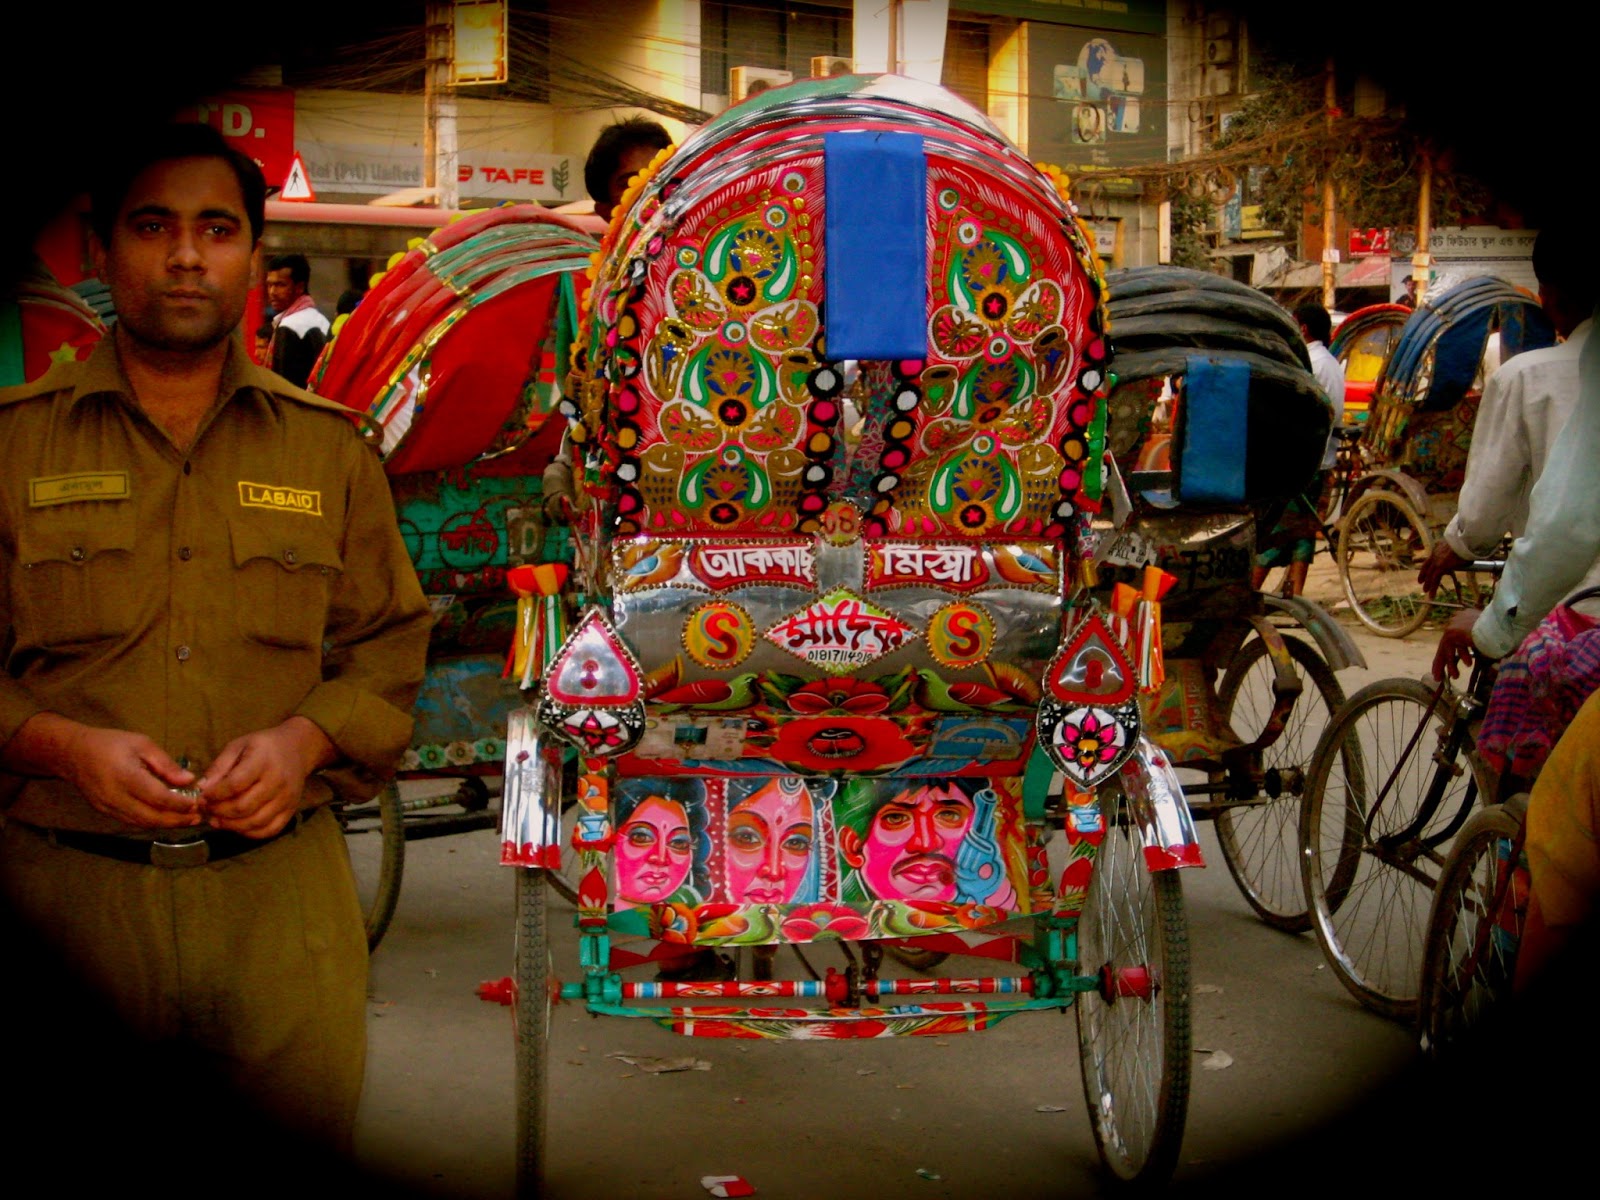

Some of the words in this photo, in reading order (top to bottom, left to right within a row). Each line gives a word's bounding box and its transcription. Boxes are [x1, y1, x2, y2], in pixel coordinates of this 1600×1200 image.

[480, 166, 544, 185] TAFE
[705, 612, 740, 660] S
[948, 611, 980, 658] S
